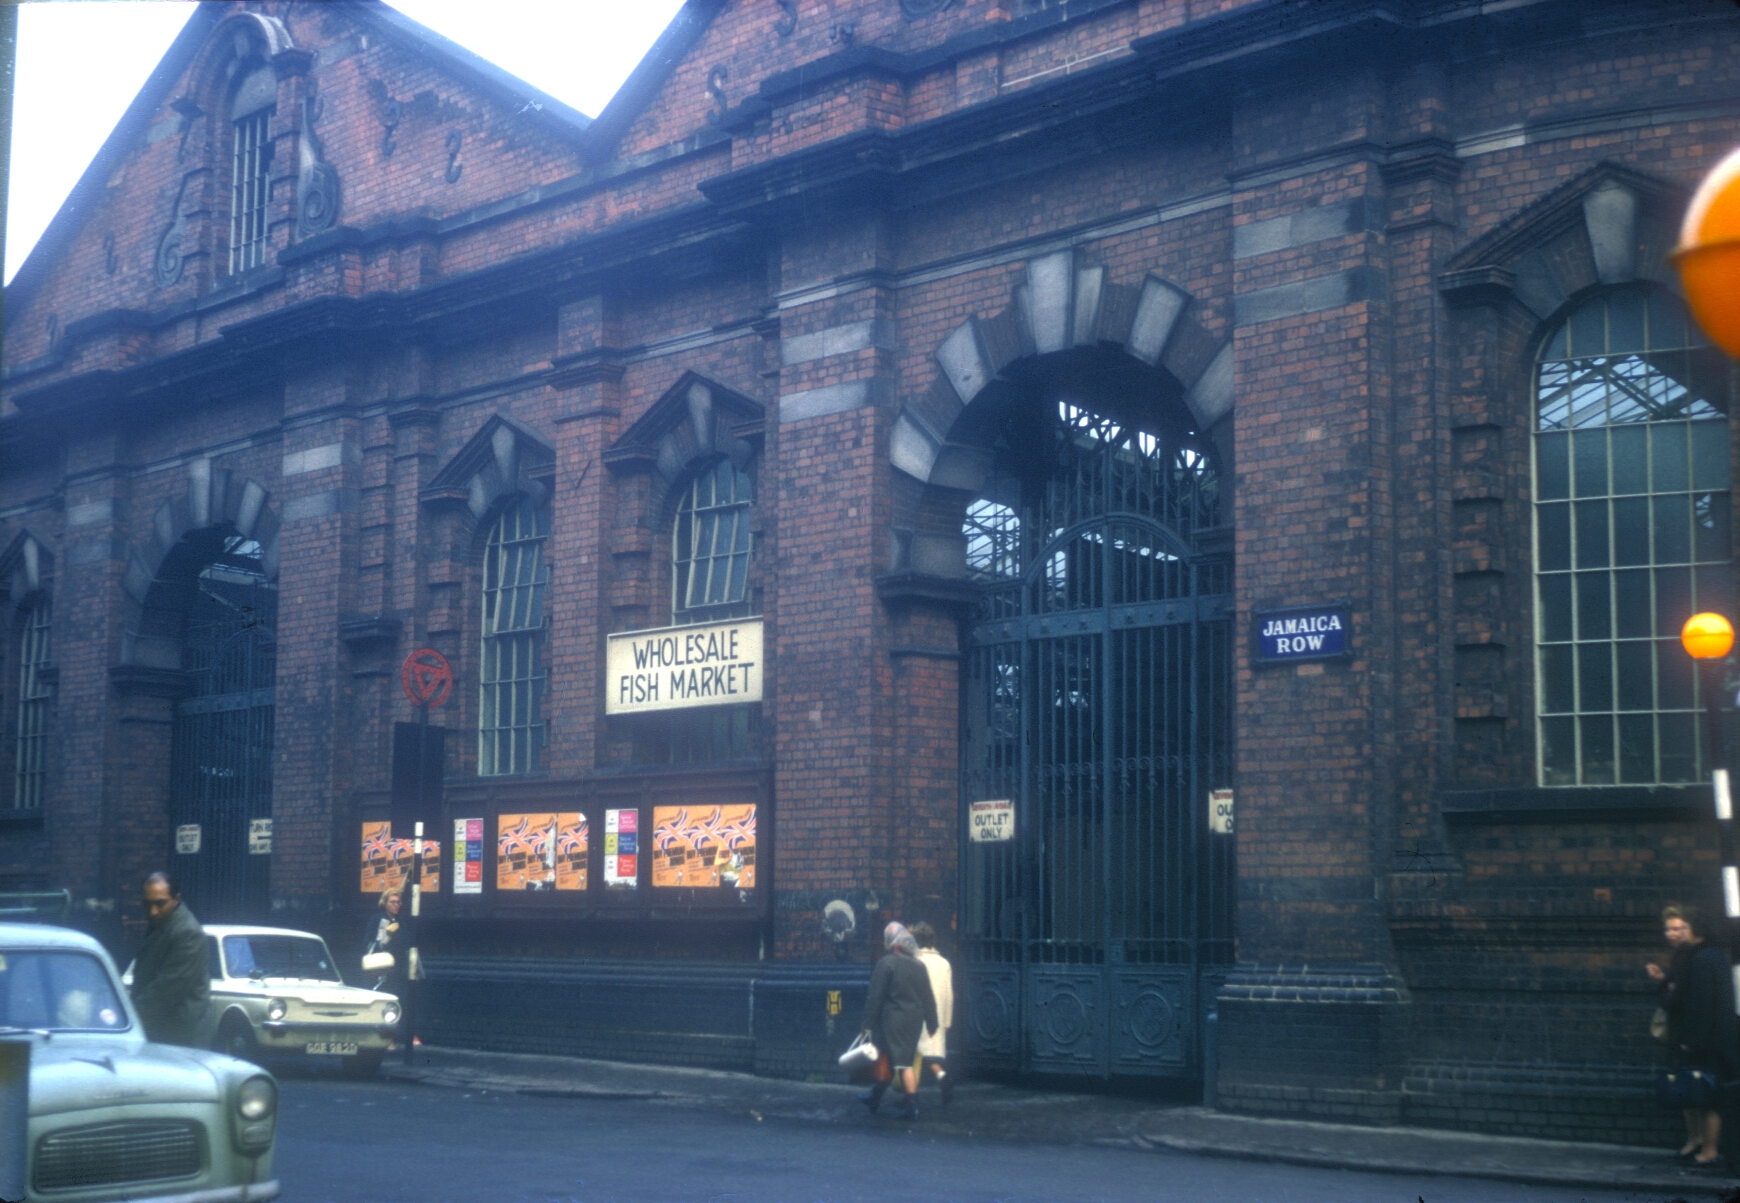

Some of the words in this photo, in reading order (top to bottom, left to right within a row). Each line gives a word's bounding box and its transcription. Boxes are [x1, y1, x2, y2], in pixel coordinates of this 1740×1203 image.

[1263, 615, 1342, 637] JAMAICA
[632, 629, 738, 670] WHOLESALE
[1276, 634, 1325, 654] ROW
[620, 672, 659, 704] FISH
[670, 662, 754, 700] MARKET
[975, 813, 1008, 826] OUTLET
[981, 827, 1002, 839] ONLY
